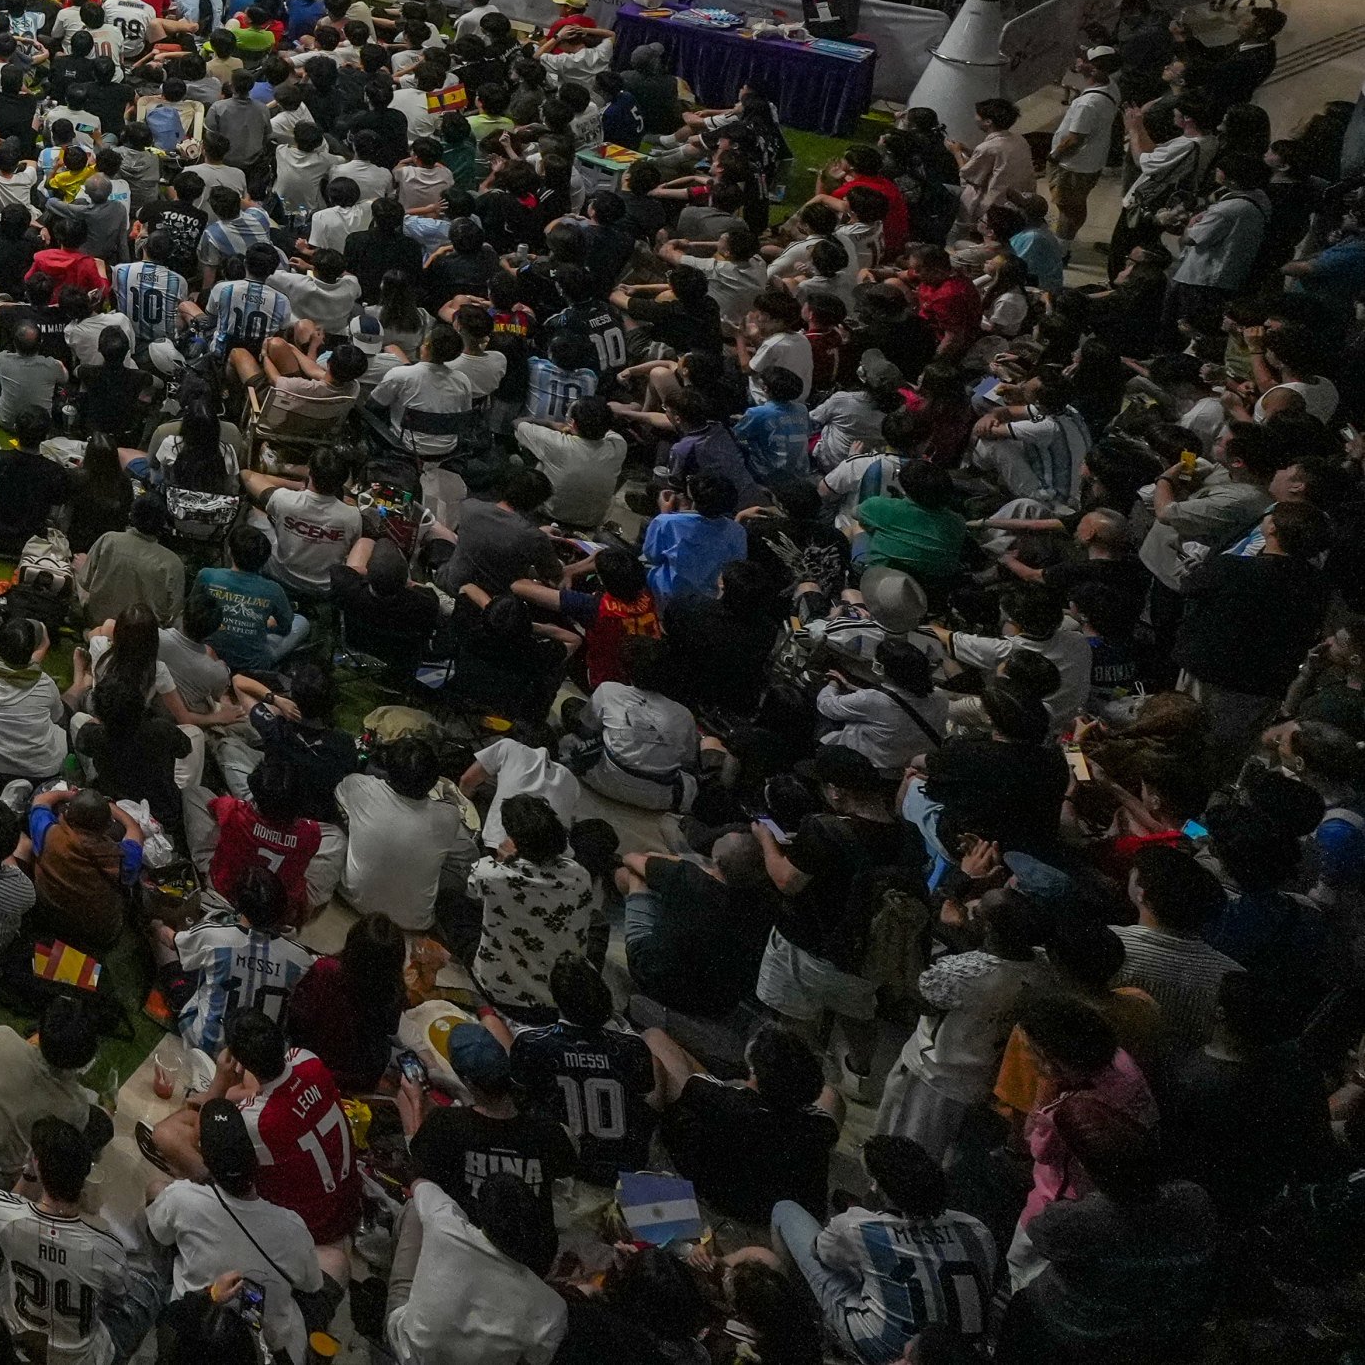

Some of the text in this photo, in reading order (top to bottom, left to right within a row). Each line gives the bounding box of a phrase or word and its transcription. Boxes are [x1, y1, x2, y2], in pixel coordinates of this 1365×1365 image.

[162, 210, 200, 228] TOKYO
[136, 272, 159, 284] MESSI
[129, 285, 163, 326] 10
[241, 292, 266, 306] MESSI
[232, 306, 267, 340] 10
[588, 313, 612, 329] MESSI
[588, 326, 626, 371] 10
[284, 516, 345, 542] SCENE
[253, 821, 298, 849] RONALDO
[235, 952, 281, 980] MESSI
[564, 1050, 610, 1070] MESSI
[290, 1083, 323, 1119] LEON
[556, 1074, 626, 1140] 10
[296, 1100, 351, 1194] 17
[10, 1259, 94, 1341] 24
